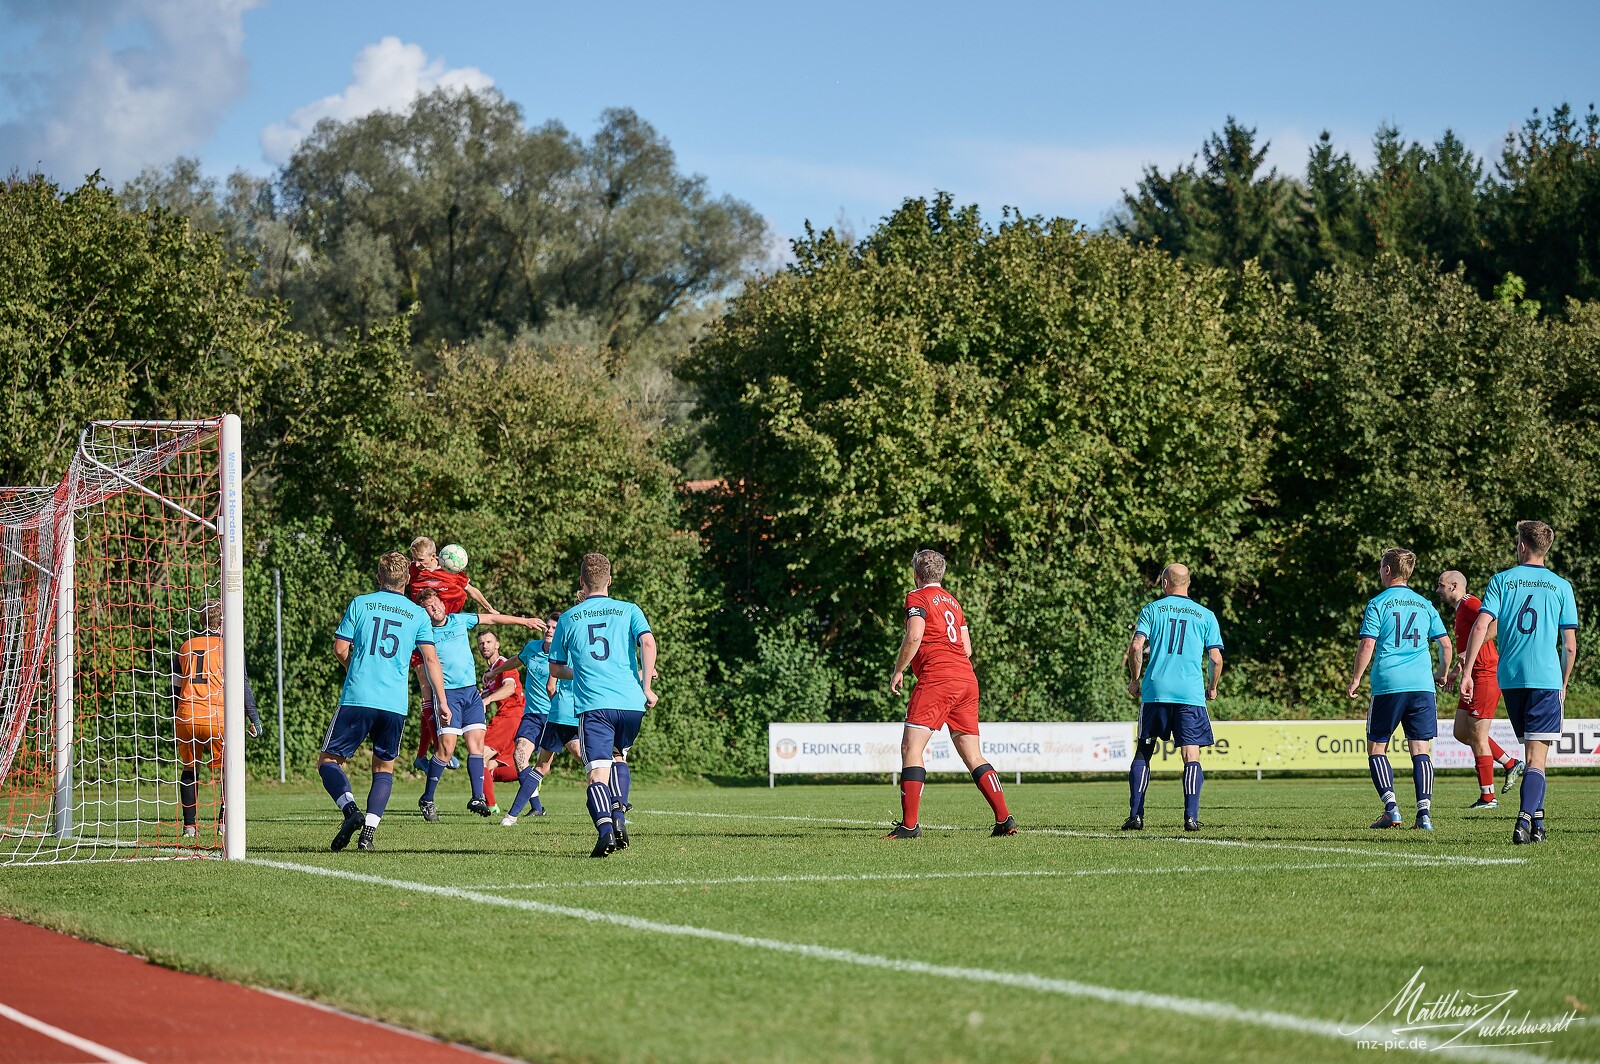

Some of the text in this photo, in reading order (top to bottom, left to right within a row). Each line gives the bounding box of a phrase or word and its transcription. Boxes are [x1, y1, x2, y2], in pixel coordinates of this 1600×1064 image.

[228, 452, 236, 487] Weller
[932, 594, 941, 606] SV
[1505, 578, 1557, 592] TSV Peterskirchen
[365, 602, 414, 621] TSV Peterskirchen
[570, 607, 624, 622] TSV Peterskirchen
[944, 610, 958, 643] 8
[1158, 604, 1203, 619] TSV Peterskirchen
[1516, 594, 1538, 635] 6
[369, 616, 403, 659] 15
[587, 622, 610, 661] 5
[1167, 617, 1187, 655] 11
[1392, 611, 1421, 648] 14
[190, 649, 208, 684] 1
[802, 742, 862, 756] ERDINGER
[982, 741, 1041, 755] ERDINGER
